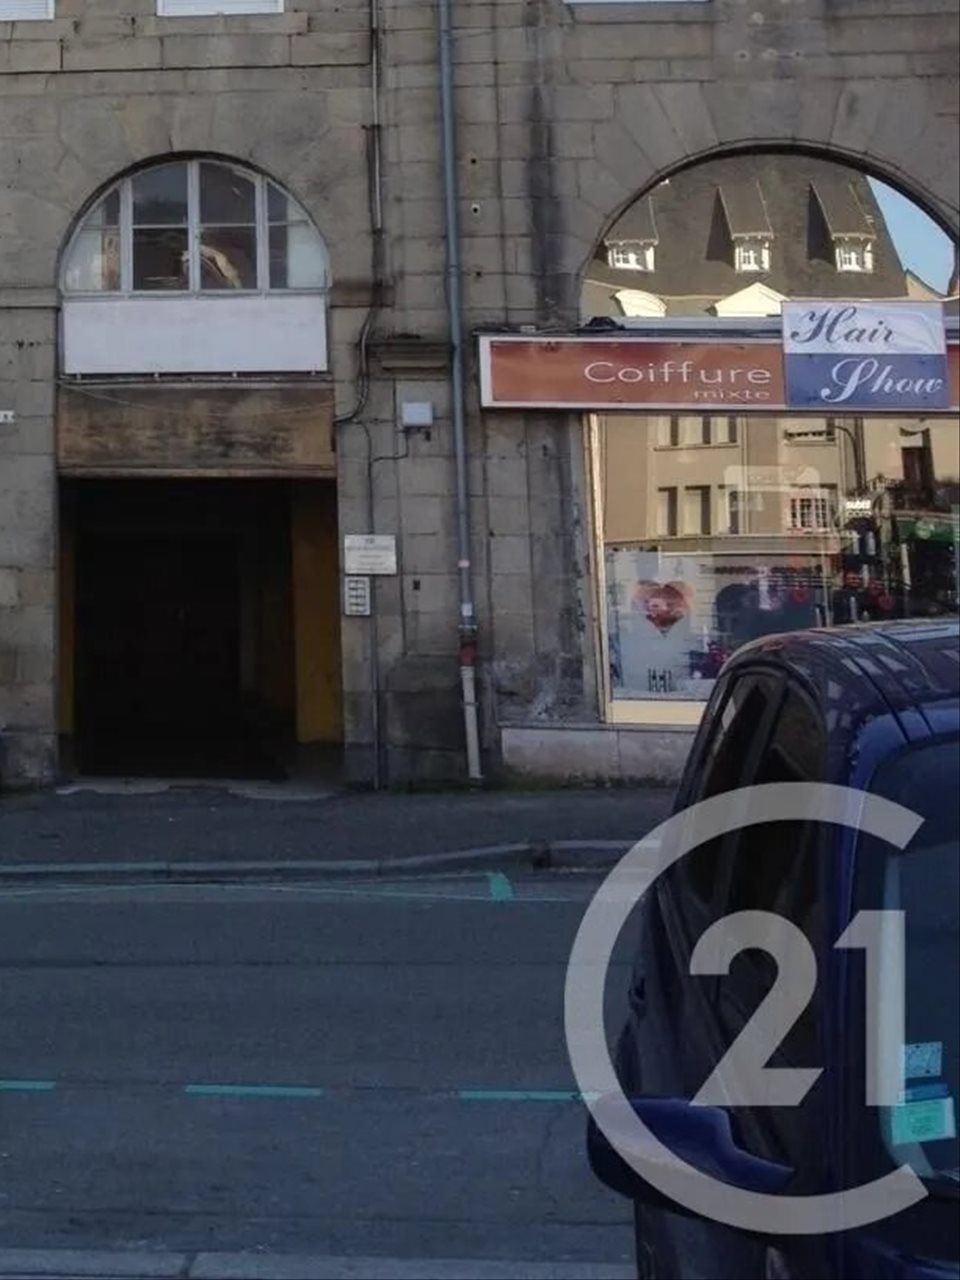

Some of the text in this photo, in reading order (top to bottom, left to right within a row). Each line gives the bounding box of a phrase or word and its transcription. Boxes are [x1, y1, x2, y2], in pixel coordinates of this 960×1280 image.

[790, 306, 896, 345] Hair
[583, 360, 772, 386] Coiffure
[820, 357, 945, 404] Show
[693, 387, 771, 401] mixte
